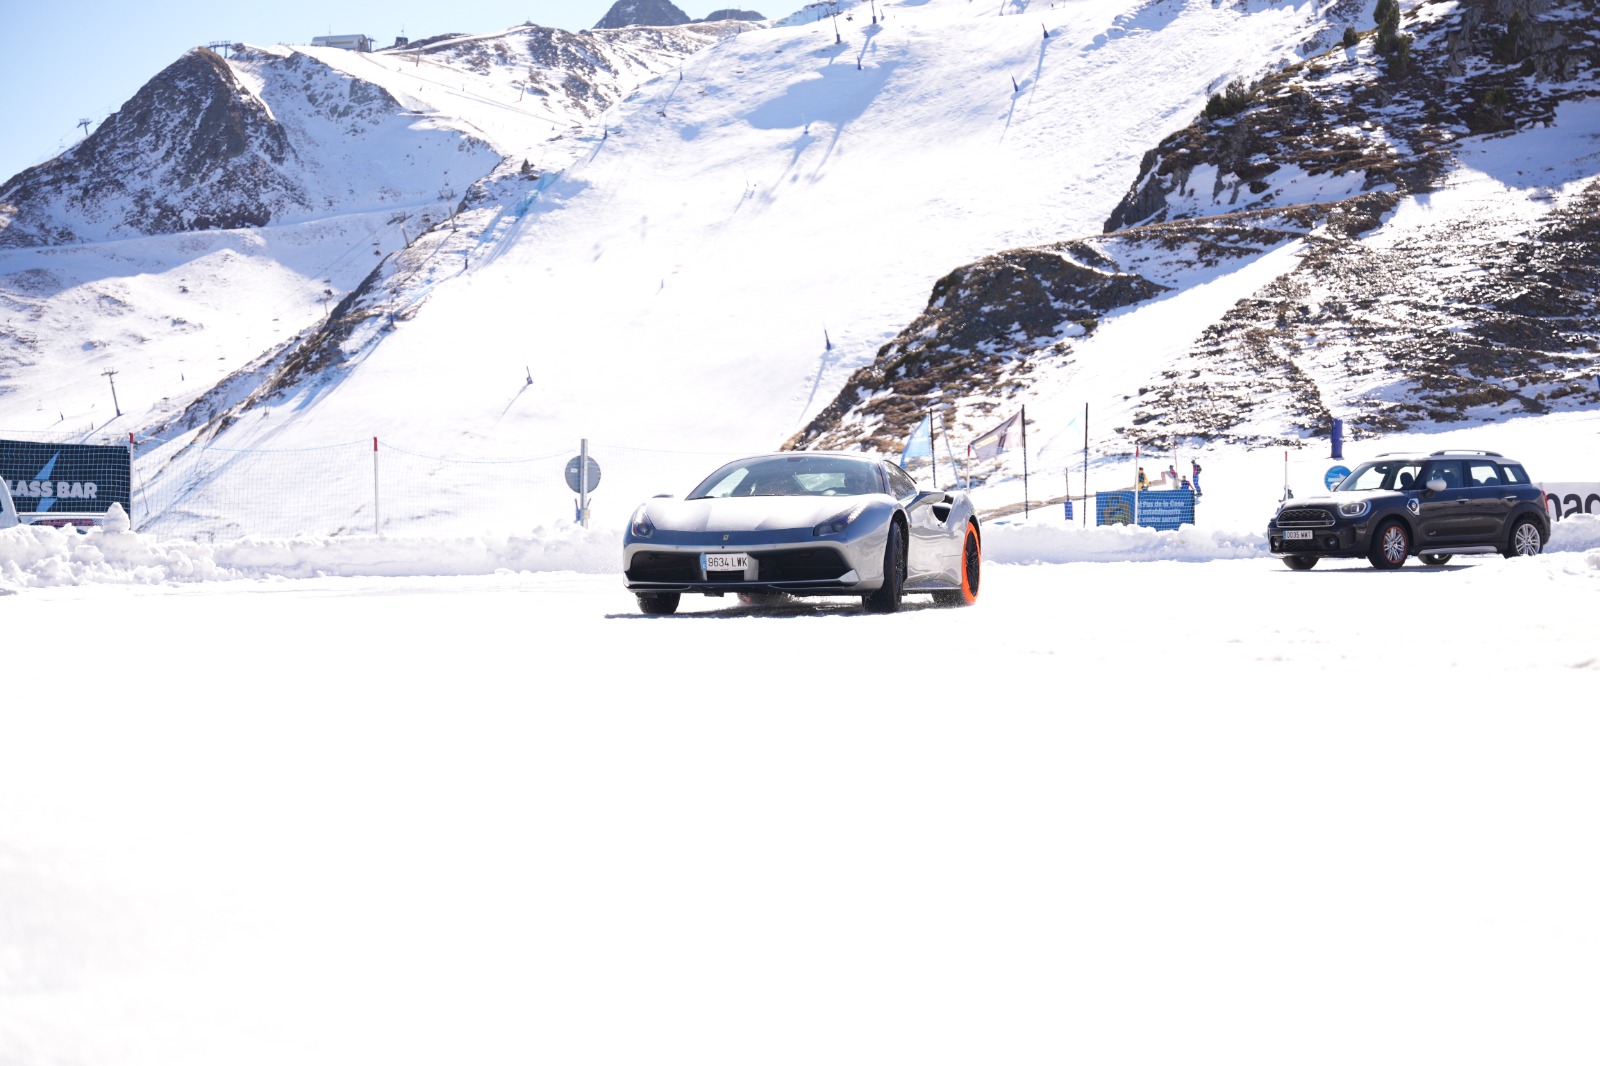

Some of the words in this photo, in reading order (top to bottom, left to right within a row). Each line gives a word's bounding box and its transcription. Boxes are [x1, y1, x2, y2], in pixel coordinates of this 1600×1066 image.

[57, 482, 97, 498] BAR
[1287, 531, 1299, 539] 0035
[707, 557, 729, 567] 9634
[731, 557, 748, 567] LWK
